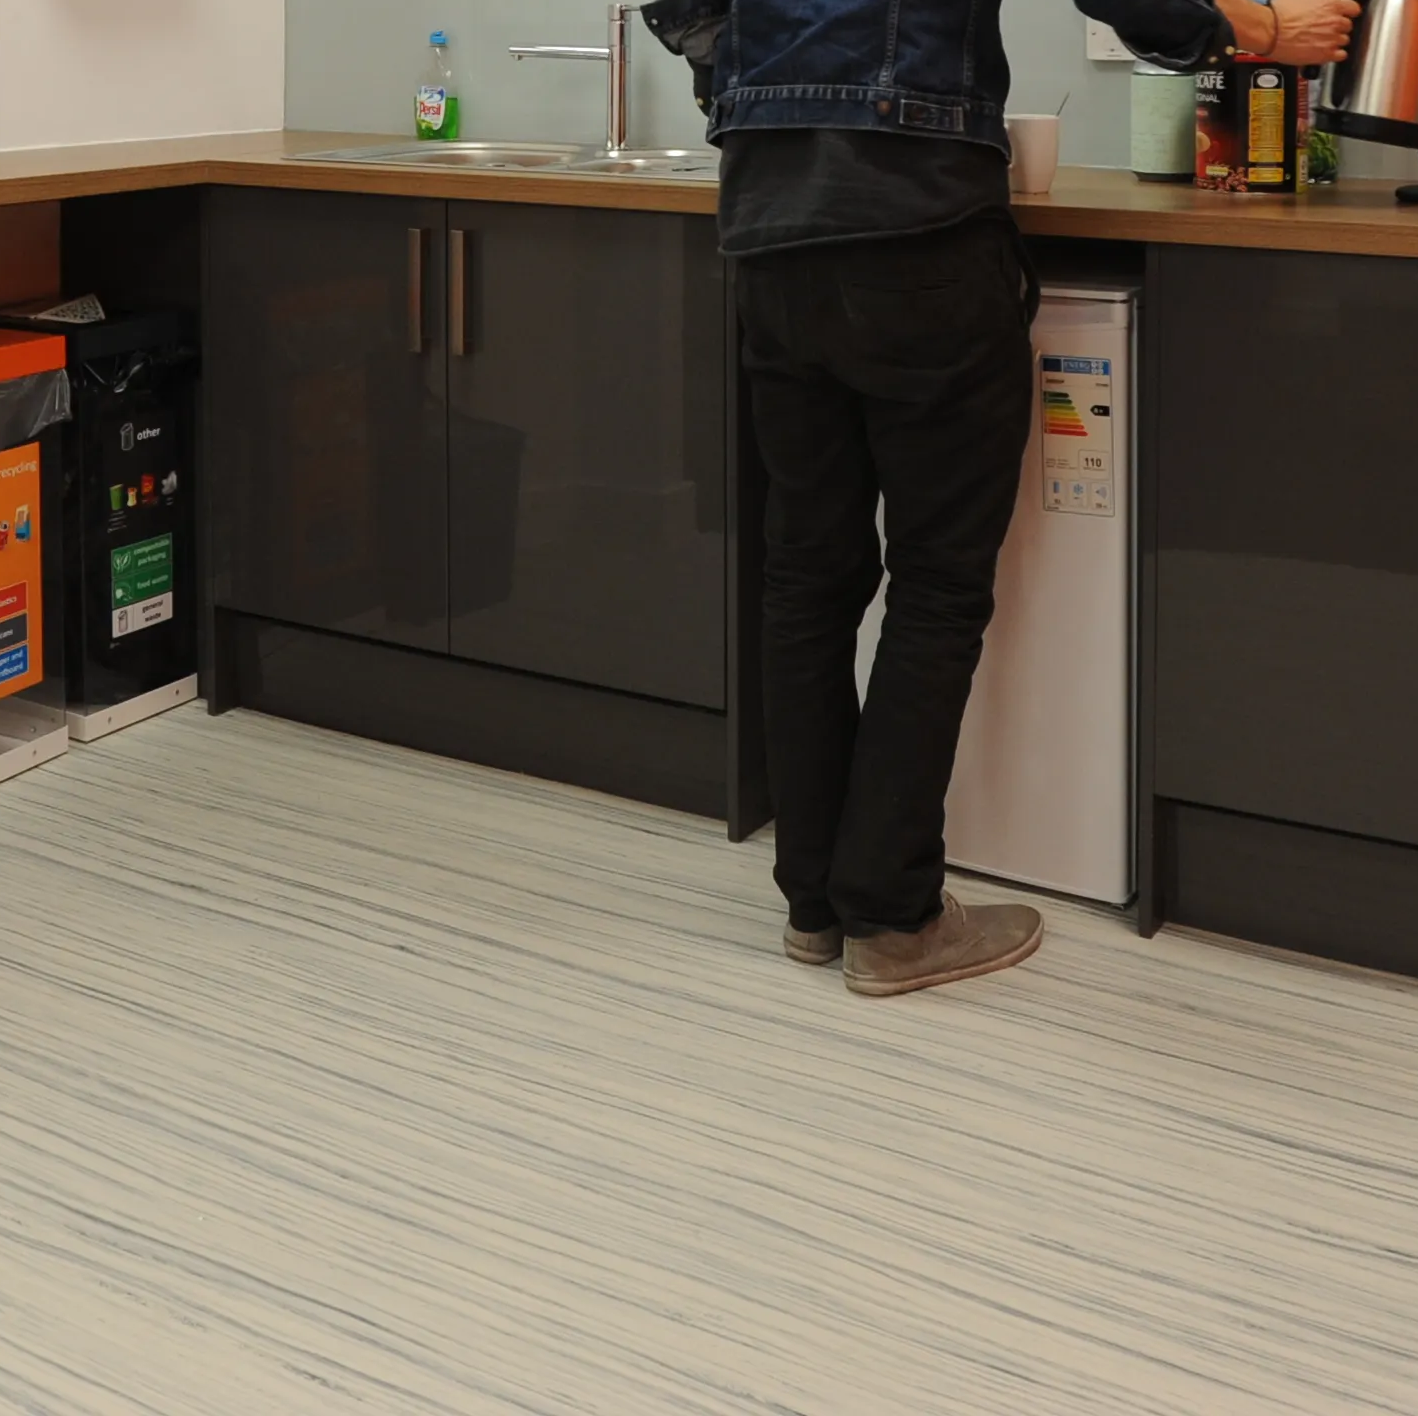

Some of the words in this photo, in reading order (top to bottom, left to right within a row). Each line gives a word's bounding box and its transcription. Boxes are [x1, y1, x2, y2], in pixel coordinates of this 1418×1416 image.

[419, 102, 441, 116] Persil
[137, 428, 161, 441] other
[1085, 457, 1102, 468] 110
